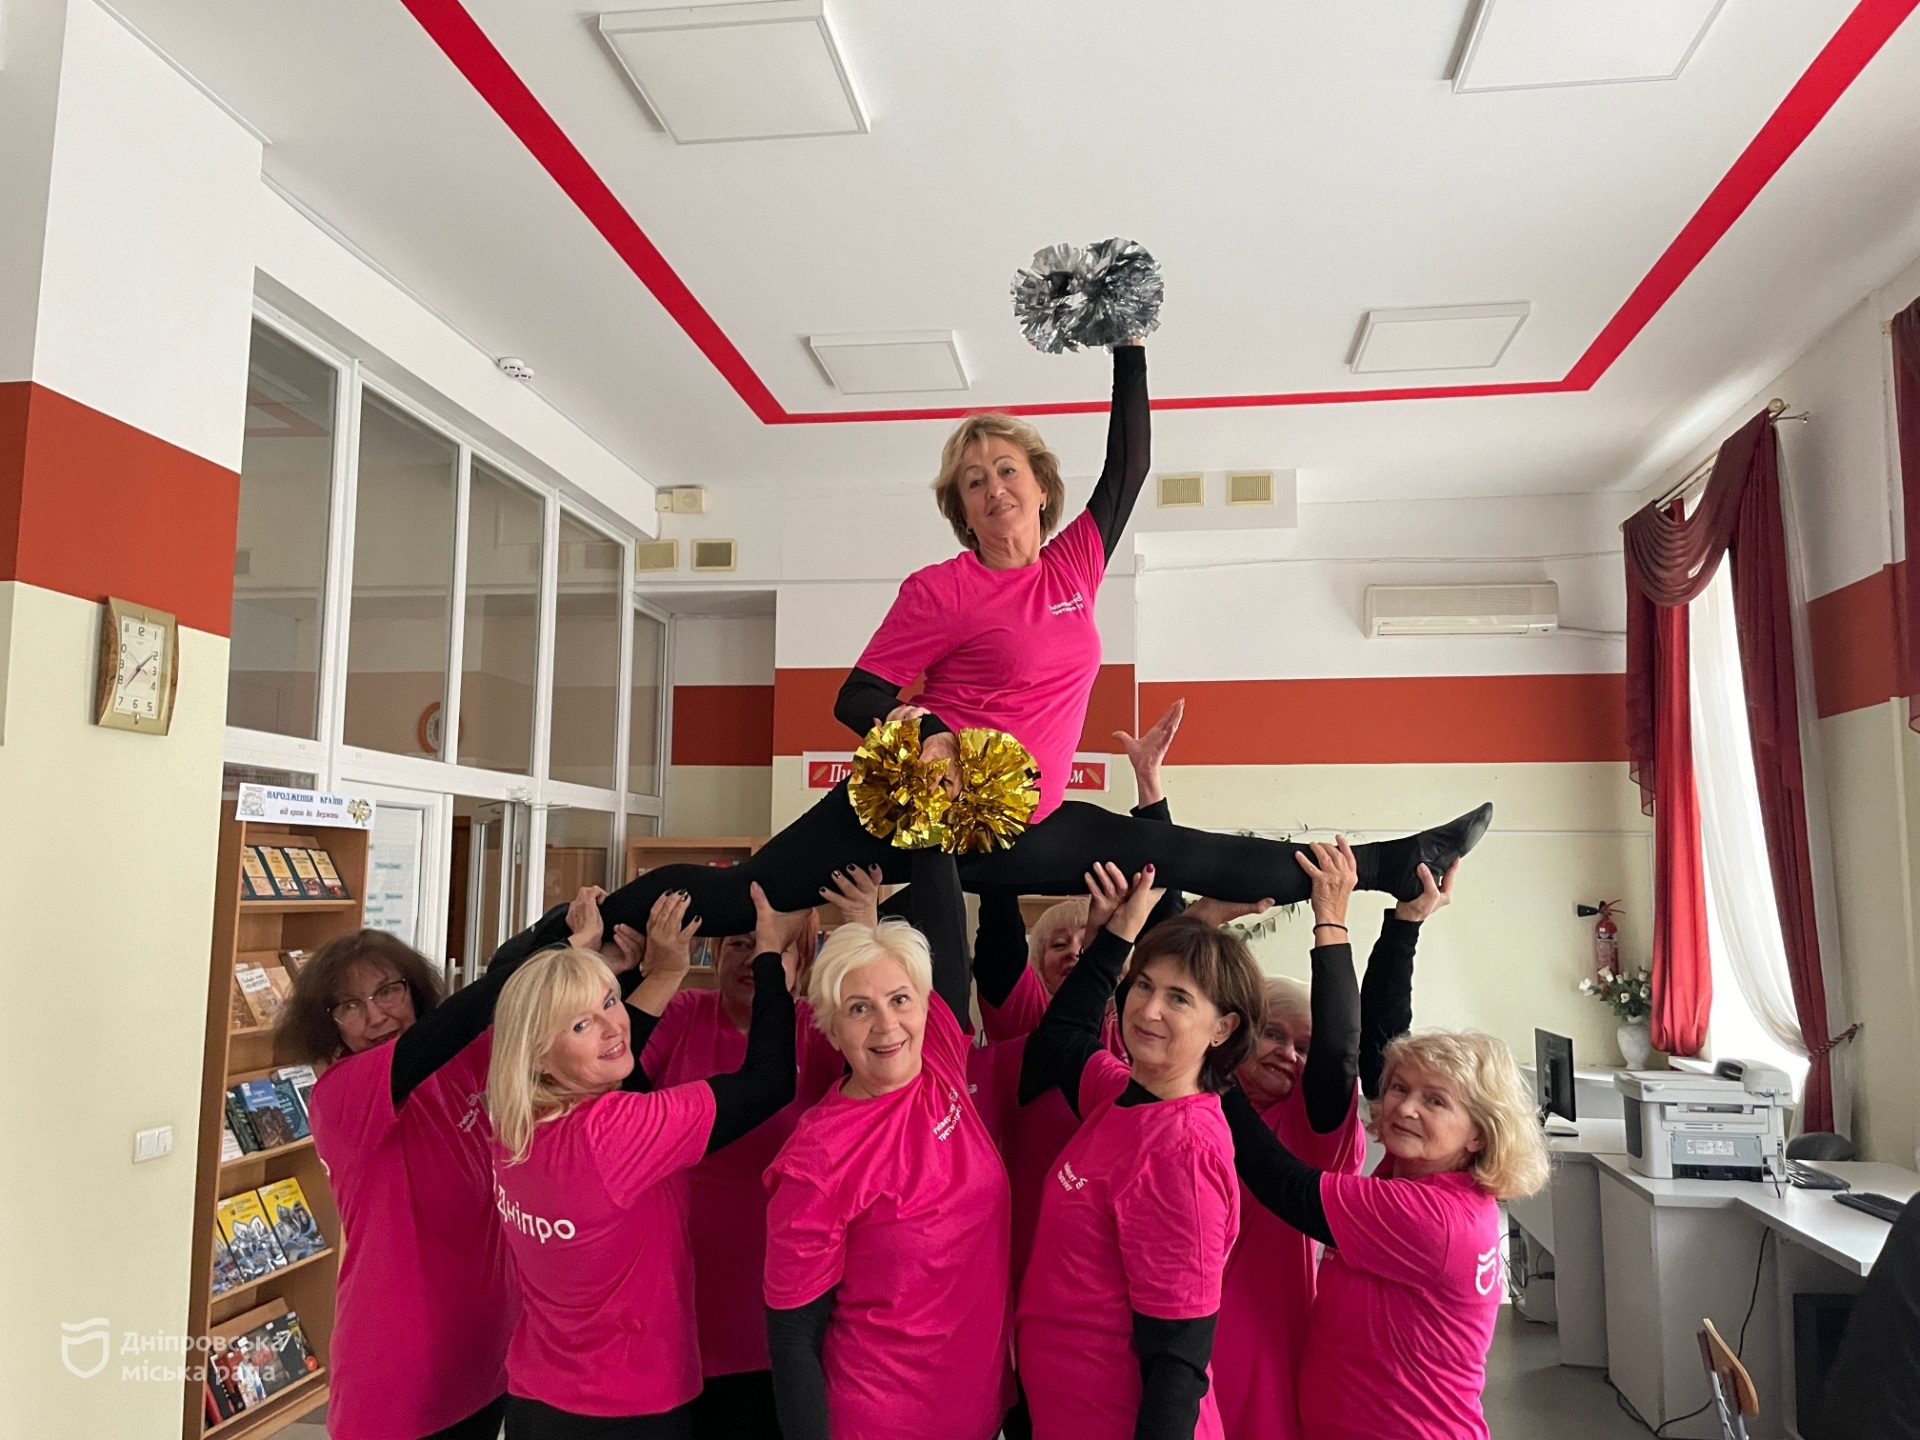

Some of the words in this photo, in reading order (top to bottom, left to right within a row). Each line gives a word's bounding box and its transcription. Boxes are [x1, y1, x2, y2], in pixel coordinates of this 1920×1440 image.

[138, 626, 145, 637] 12
[154, 631, 157, 640] 1
[121, 644, 127, 653] 0
[153, 651, 158, 661] 2
[152, 667, 157, 676] 3
[118, 675, 124, 685] 8
[151, 682, 156, 691] 4
[118, 696, 124, 706] 7
[133, 699, 138, 709] 6
[147, 702, 153, 712] 5
[828, 764, 852, 783] Пи
[1070, 769, 1084, 784] м
[266, 790, 314, 803] НАРОДЖЕННЯ
[320, 795, 343, 806] КРАЇНИ
[280, 807, 289, 815] від
[290, 809, 305, 817] краю
[306, 809, 313, 817] до
[315, 810, 339, 820] держави
[497, 1184, 576, 1244] Дніпро
